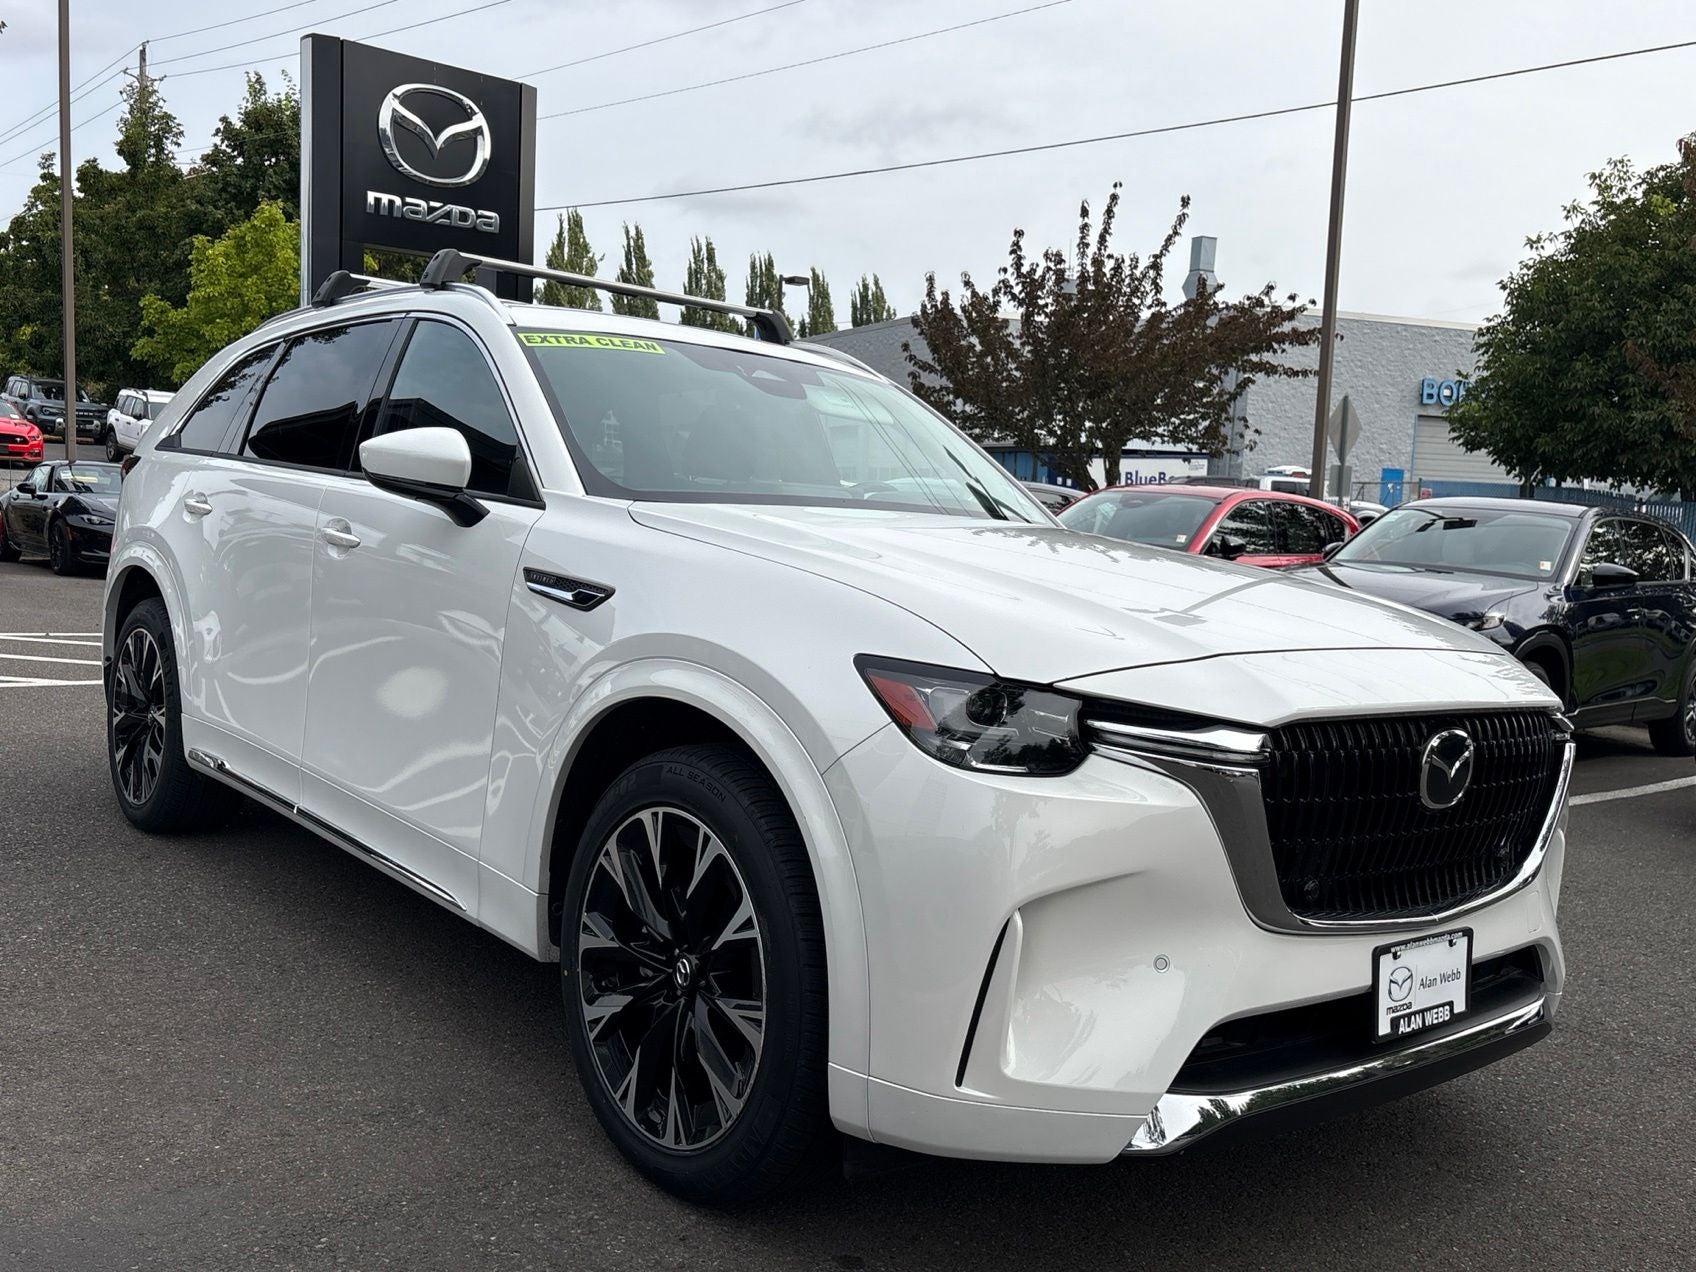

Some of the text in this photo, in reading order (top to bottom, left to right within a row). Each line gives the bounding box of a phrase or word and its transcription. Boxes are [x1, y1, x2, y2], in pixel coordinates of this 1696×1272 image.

[366, 190, 500, 233] mazda
[523, 335, 659, 352] EXTRA CLEAN
[1421, 378, 1466, 406] BO
[1125, 469, 1168, 485] BlueB
[665, 766, 727, 802] ALL SEASON
[1418, 968, 1461, 991] Alan Webb
[1398, 1005, 1451, 1035] ALAN WEBB
